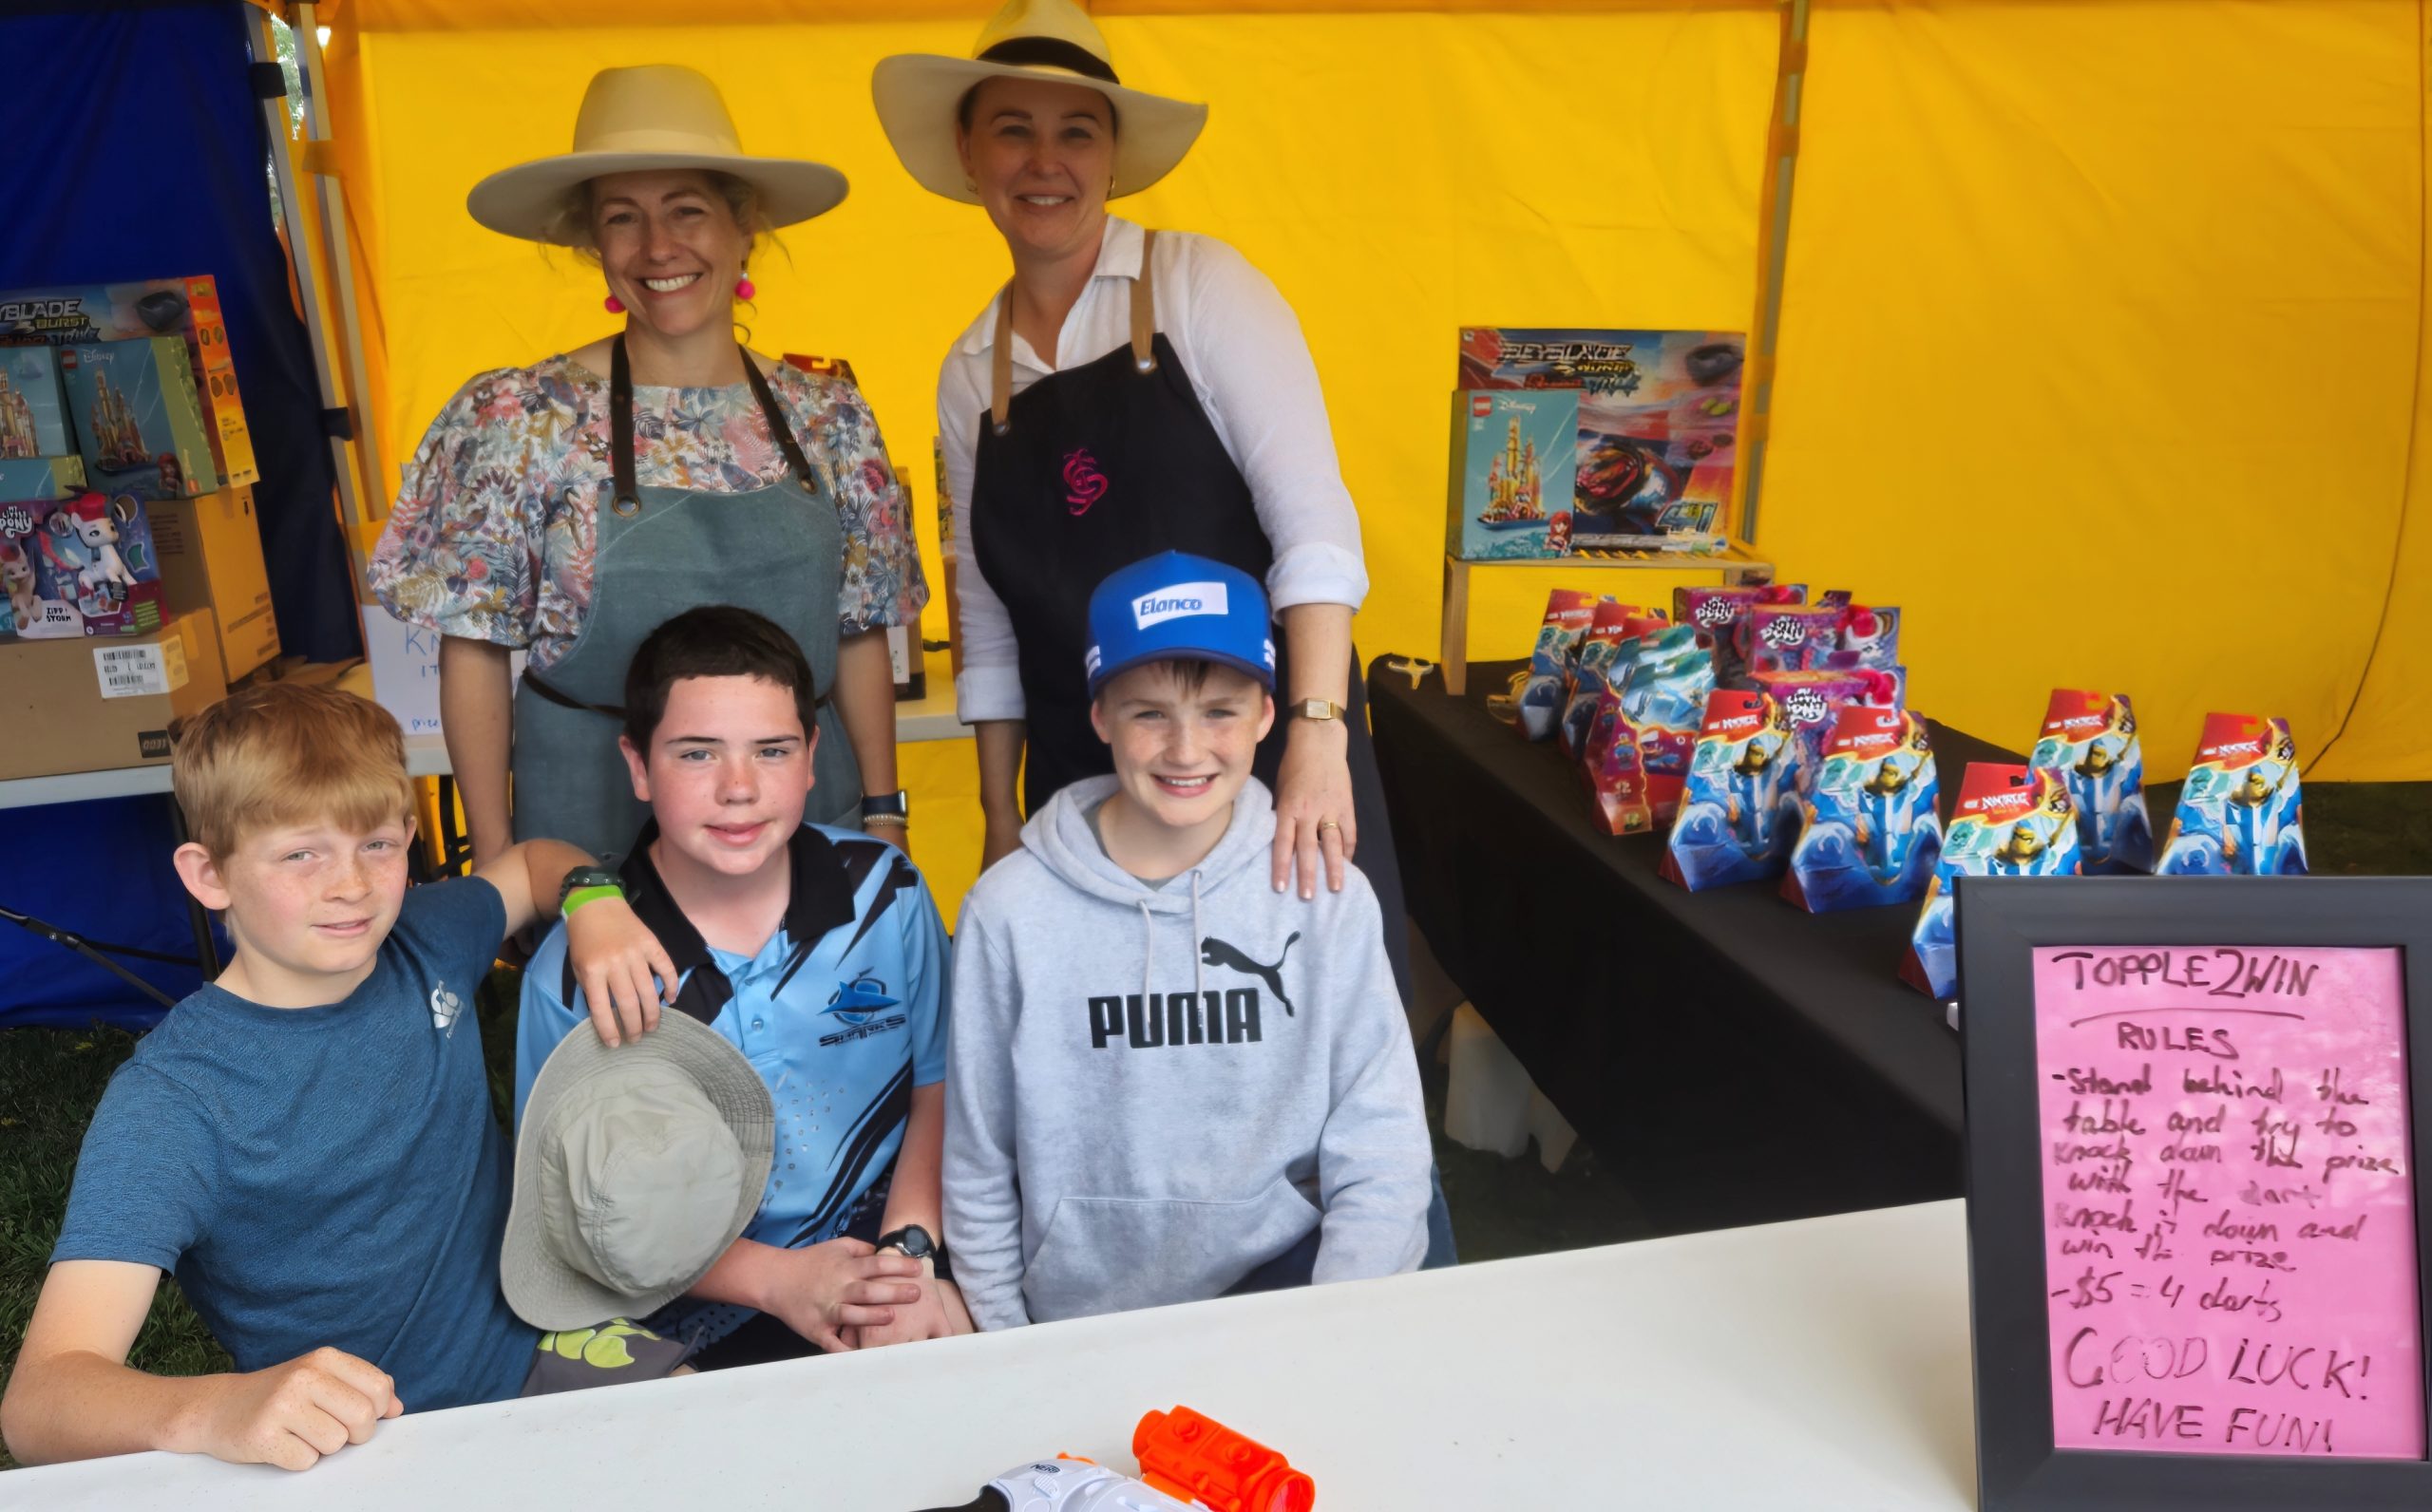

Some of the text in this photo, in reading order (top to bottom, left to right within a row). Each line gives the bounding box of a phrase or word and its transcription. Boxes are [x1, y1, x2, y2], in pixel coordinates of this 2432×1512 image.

[1140, 597, 1203, 616] Elanco
[1088, 988, 1263, 1049] PUMA
[2118, 1022, 2239, 1059] RULES
[2183, 1065, 2283, 1104] behind
[2316, 1067, 2368, 1105] the
[2062, 1099, 2357, 1143] table and try to
[2251, 1136, 2303, 1168] the
[2324, 1144, 2400, 1184] prize
[2067, 1163, 2132, 1193] with
[2157, 1169, 2209, 1204] the
[2062, 1230, 2114, 1259] win
[2203, 1209, 2279, 1241] down
[2297, 1214, 2367, 1241] and
[2159, 1275, 2185, 1309] 4
[2199, 1276, 2283, 1323] darts
[2228, 1337, 2372, 1401] LUCK!
[2093, 1397, 2334, 1454] HAVE FUN!
